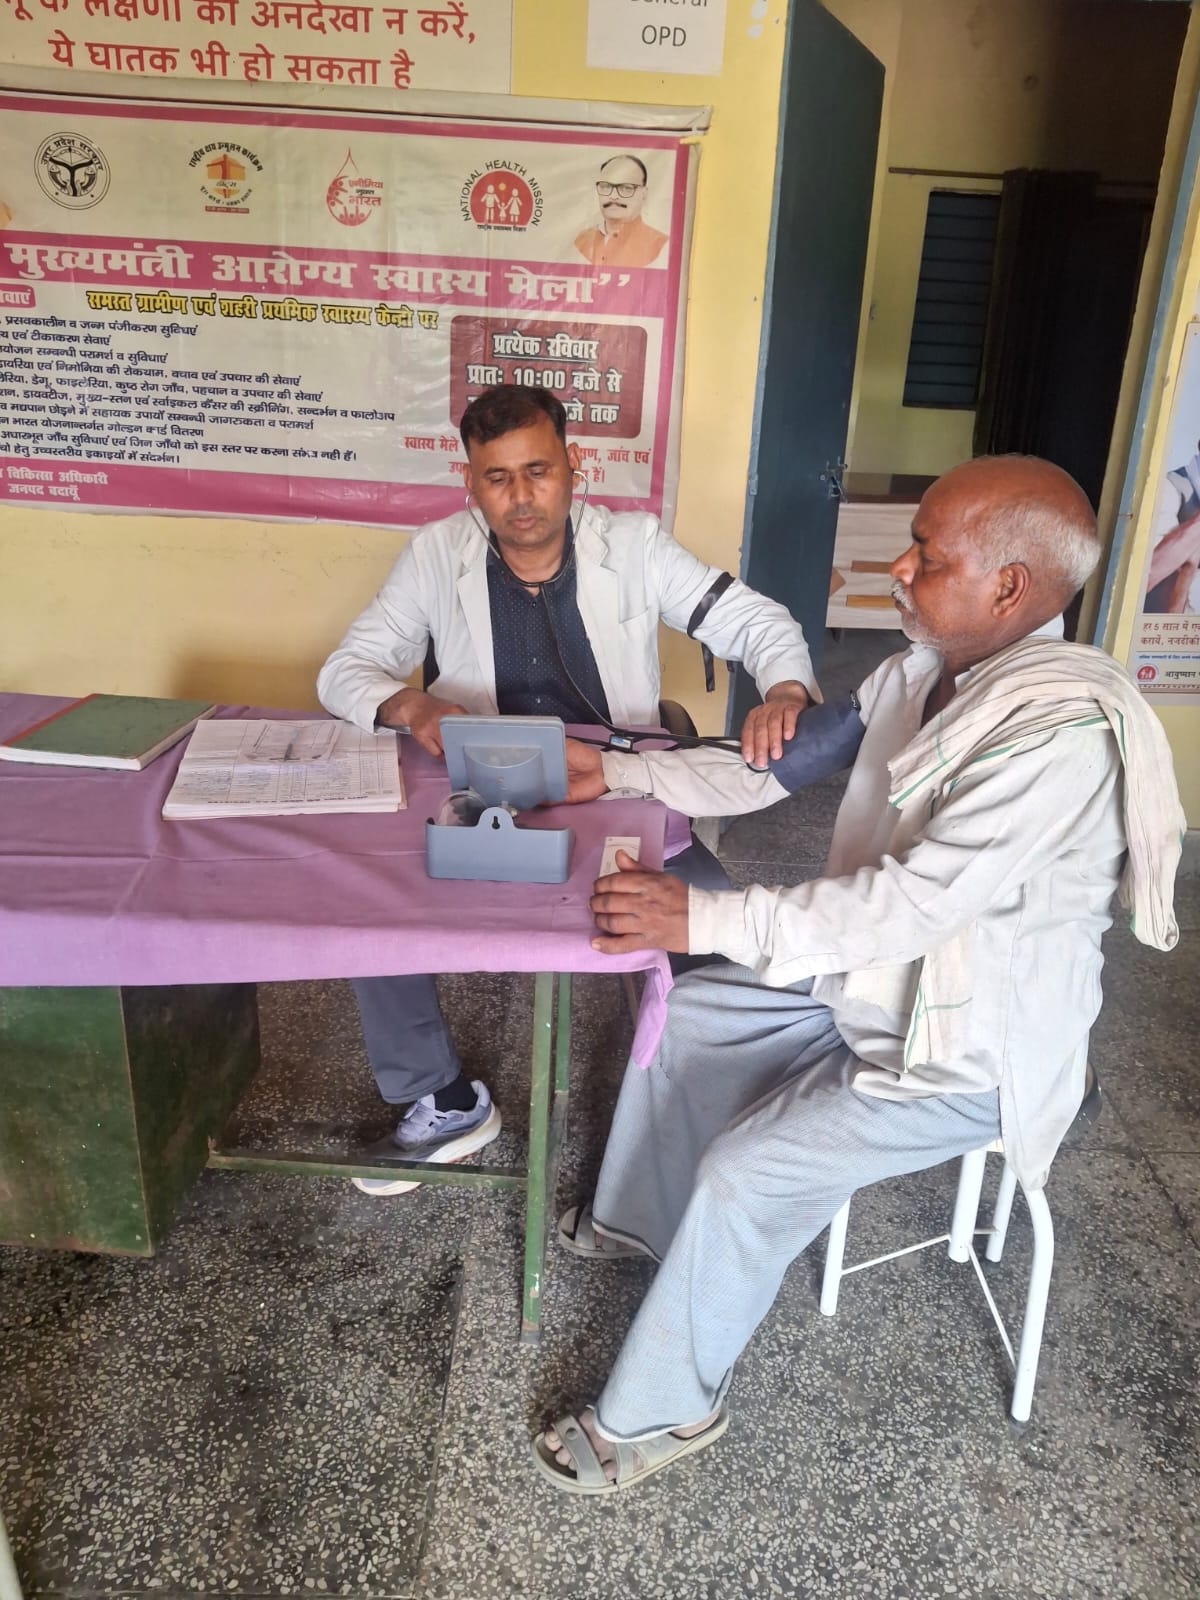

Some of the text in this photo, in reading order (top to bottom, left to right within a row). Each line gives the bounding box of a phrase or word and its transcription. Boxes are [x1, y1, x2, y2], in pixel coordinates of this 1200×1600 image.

[251, 0, 374, 34] अनदेखा
[382, 8, 408, 34] न
[417, 1, 475, 44] करें,
[641, 25, 687, 47] OPD
[48, 29, 415, 90] ये घातक भी हो सकता है
[460, 159, 544, 227] NATIONAL HEALTH MISSION
[3, 243, 194, 280] मुख्यमंत्री
[212, 250, 358, 288] आरोग्य
[0, 289, 32, 305] वाएं
[86, 290, 132, 311] समस्त
[135, 290, 188, 315] ग्रामीण
[191, 292, 217, 317] एवं
[219, 294, 258, 319] शहरी
[417, 308, 439, 330] पर
[12, 329, 29, 340] एवं
[31, 329, 80, 343] टीकाकरण
[492, 330, 600, 361] प्रत्येक रविवार
[0, 342, 33, 355] योजन
[37, 360, 54, 371] एवं
[106, 363, 120, 375] की
[201, 369, 219, 380] एवं
[255, 372, 270, 384] की
[513, 367, 566, 390] 10:00
[571, 366, 602, 392] बजे
[605, 369, 623, 393] से
[134, 395, 151, 405] एवं
[230, 400, 244, 411] की
[277, 388, 291, 400] की
[590, 403, 621, 425] तक
[170, 424, 204, 437] वितरण
[112, 436, 128, 446] एवं
[129, 436, 152, 448] जिन
[184, 440, 199, 450] को
[201, 443, 218, 452] इस
[221, 444, 242, 454] स्तर
[244, 445, 258, 455] पर
[439, 435, 460, 453] मेले
[634, 446, 652, 465] एवं
[1154, 623, 1160, 631] 5
